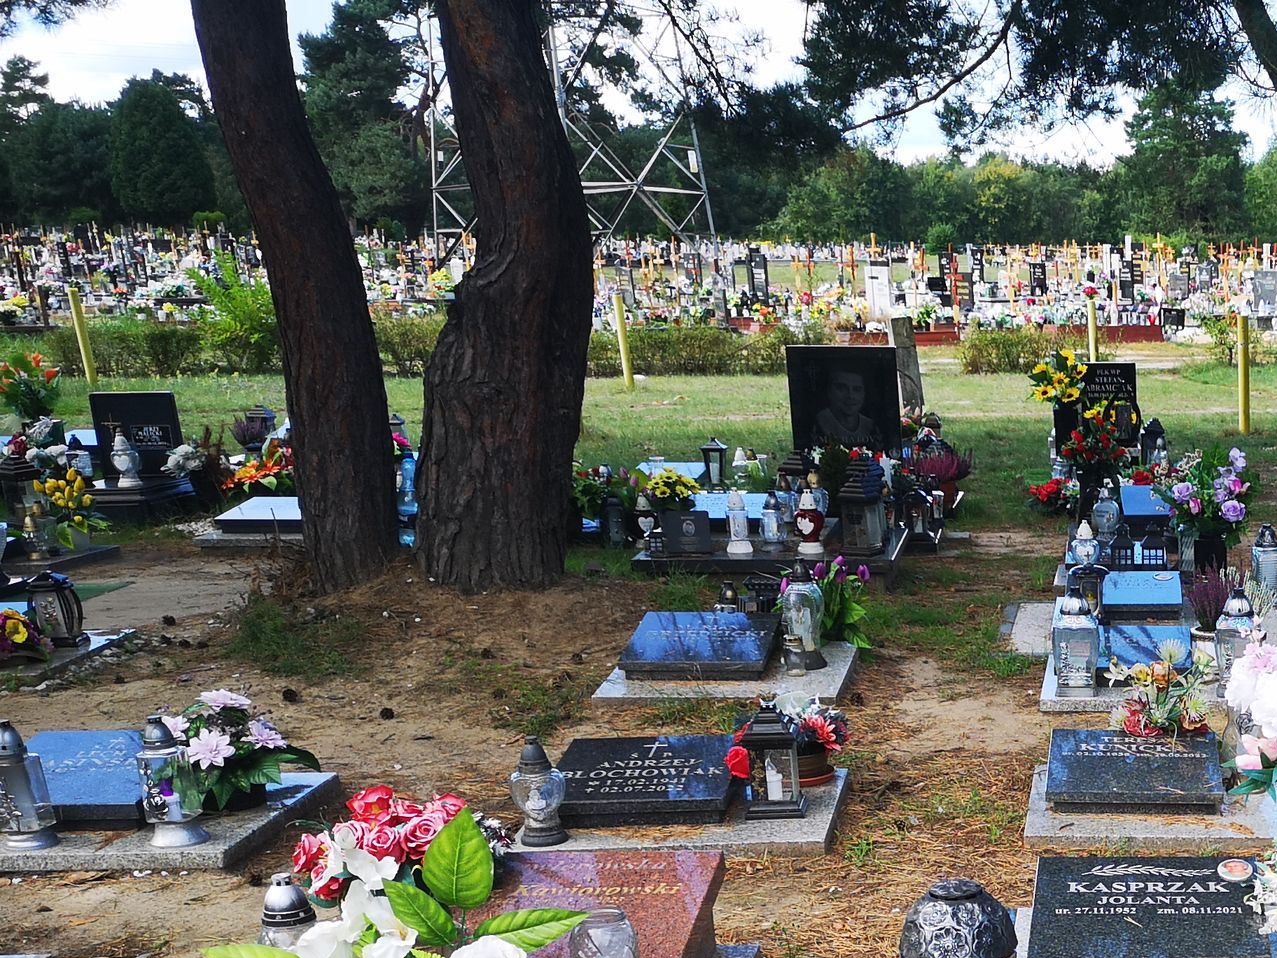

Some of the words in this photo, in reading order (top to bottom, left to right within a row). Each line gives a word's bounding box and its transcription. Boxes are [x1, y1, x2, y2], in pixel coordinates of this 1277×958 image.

[598, 758, 702, 768] ANDRZEJ
[510, 883, 682, 897] Kawiorowski
[1067, 882, 1230, 893] KASPRZAK
[1097, 896, 1200, 905] JOLANTA
[1074, 907, 1137, 915] 27.11.1952
